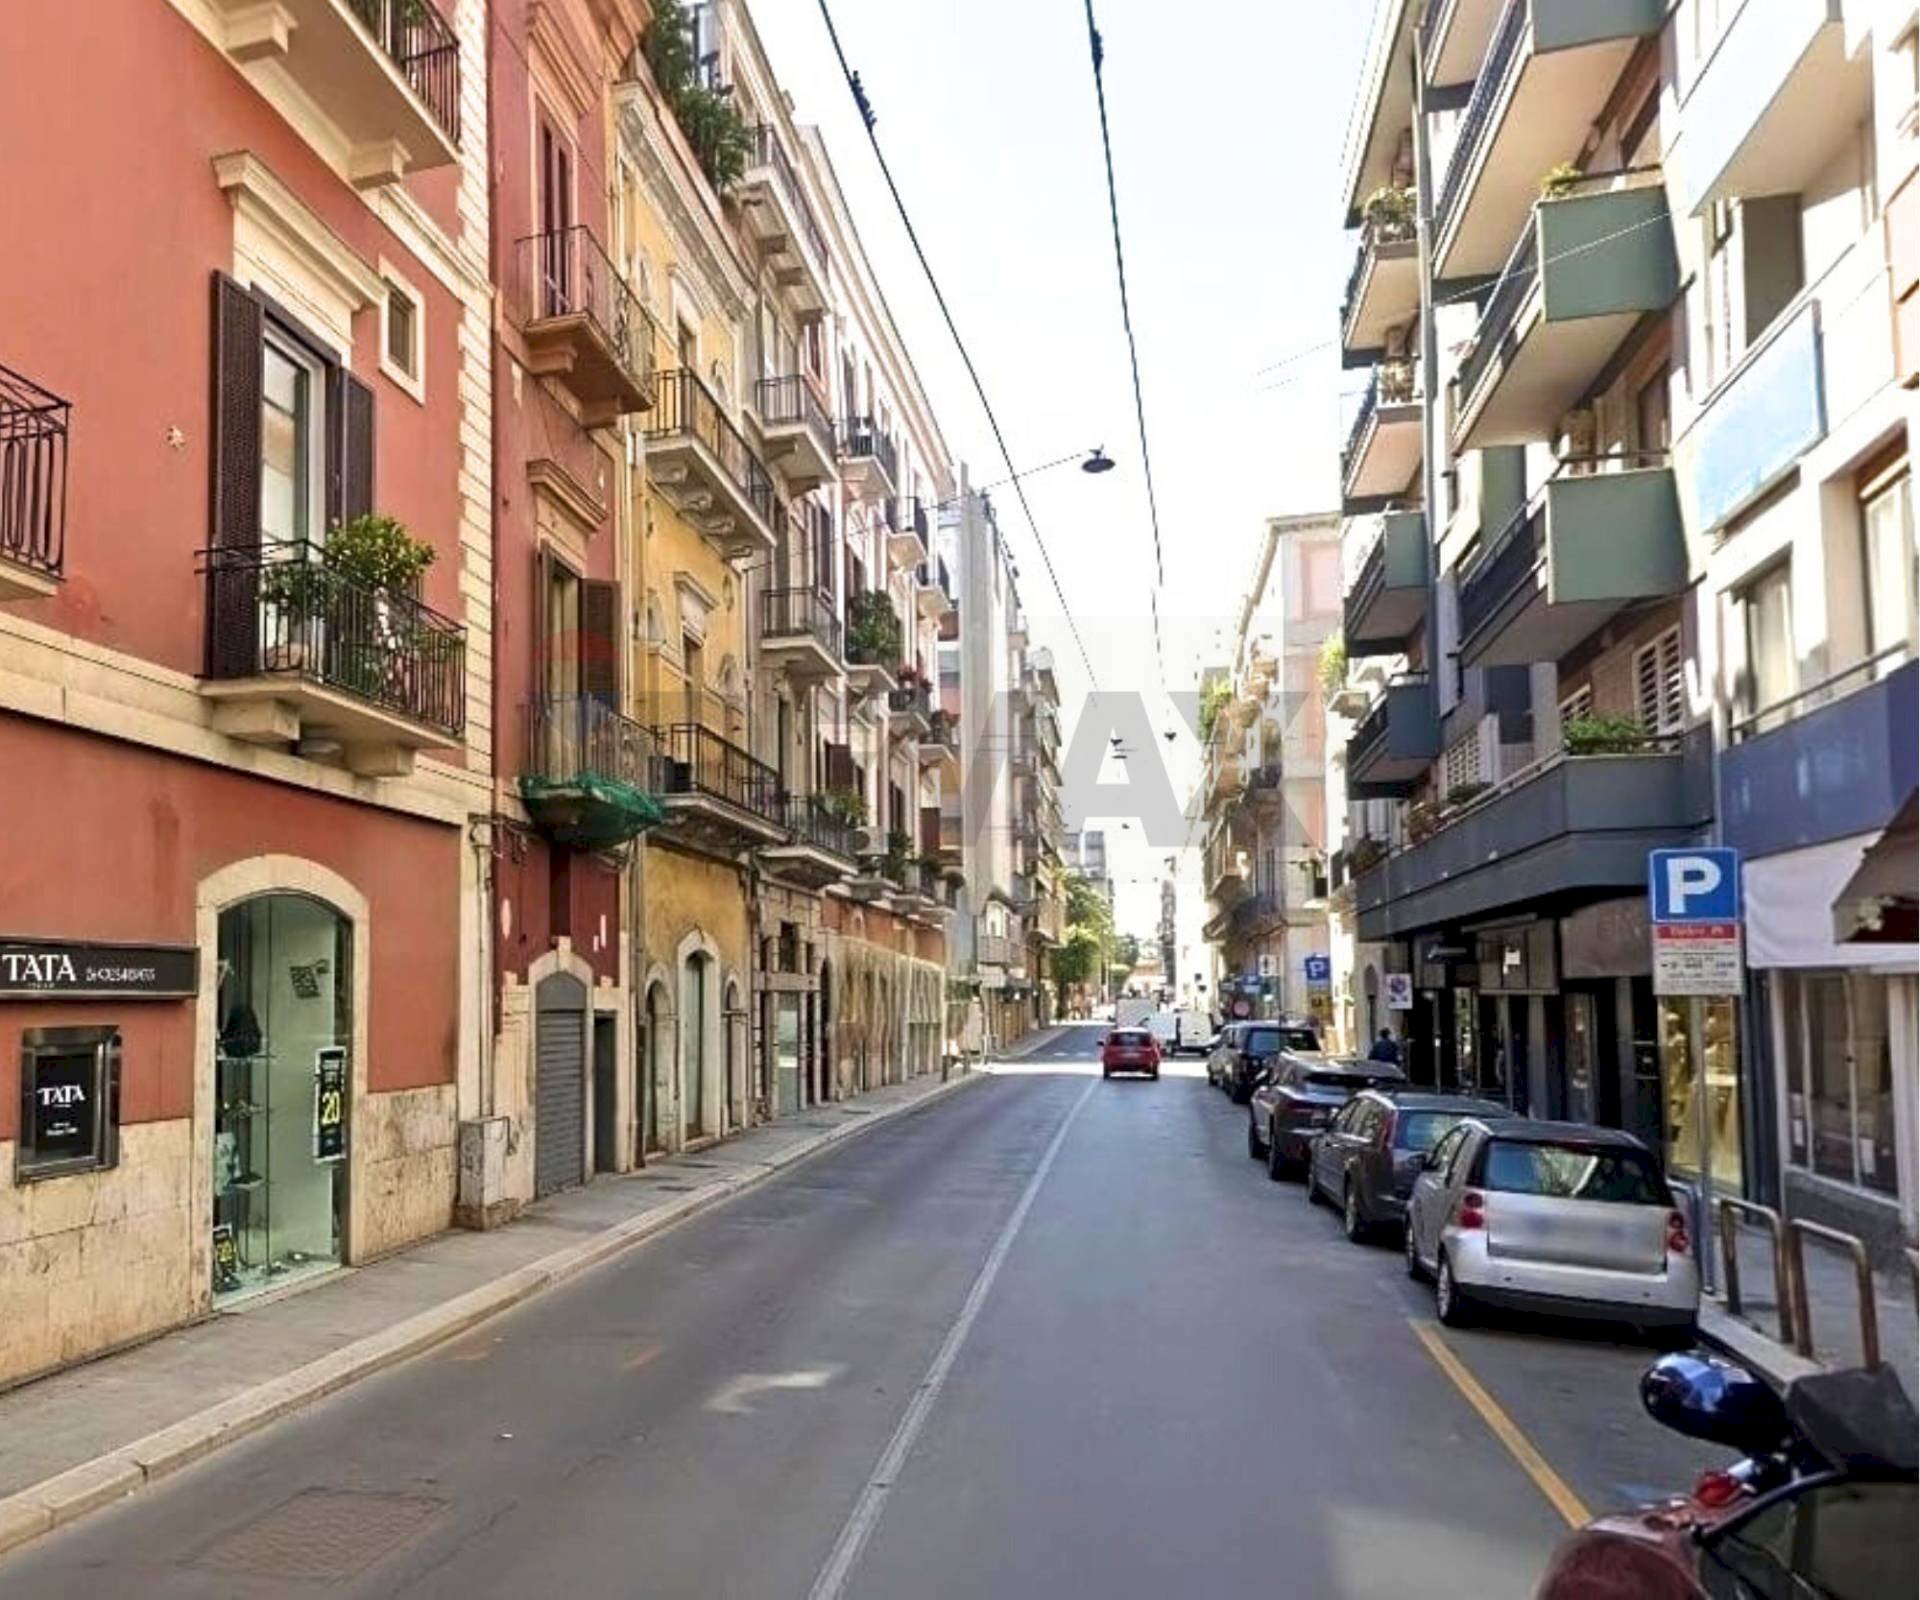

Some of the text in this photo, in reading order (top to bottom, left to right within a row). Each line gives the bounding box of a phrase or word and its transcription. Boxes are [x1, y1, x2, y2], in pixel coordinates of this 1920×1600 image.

[1666, 856, 1721, 914] P
[1, 953, 77, 982] TATA
[36, 1084, 86, 1106] TATA
[322, 1091, 340, 1125] 20
